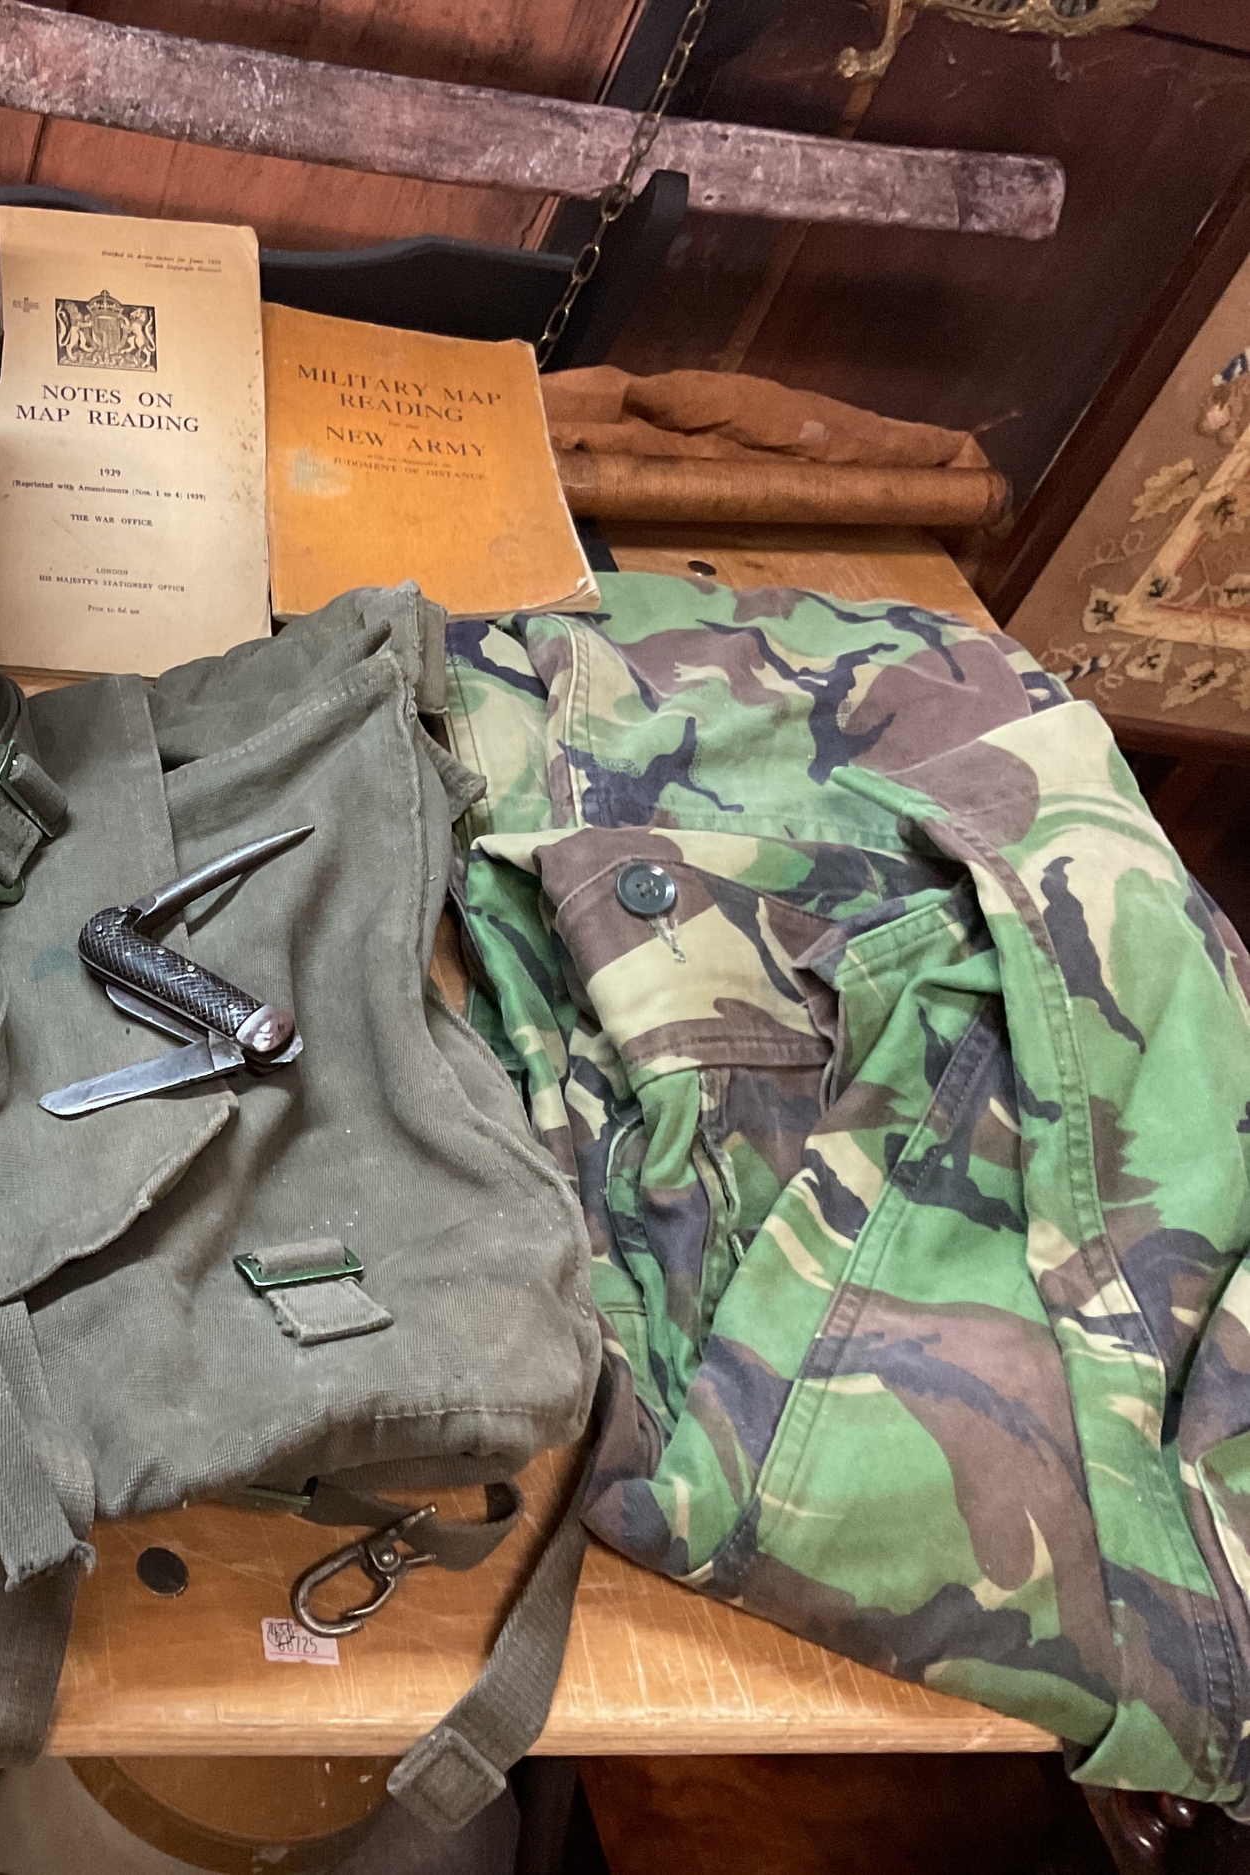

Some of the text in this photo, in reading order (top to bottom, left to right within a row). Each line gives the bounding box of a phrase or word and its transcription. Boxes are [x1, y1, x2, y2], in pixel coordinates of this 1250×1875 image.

[297, 363, 501, 406] MILITARY MAP
[42, 384, 173, 408] NOTES ON
[340, 393, 464, 423] READING
[15, 404, 199, 433] MAP READING
[326, 425, 486, 458] NEW ARMY
[99, 468, 121, 477] 1929
[333, 456, 397, 473] JUDGMENT
[57, 482, 74, 491] with
[78, 484, 129, 494] Amendments
[70, 513, 153, 527] THE WAR OFFICE
[96, 567, 129, 576] LONDON
[39, 574, 185, 592] HIS MAJESTY'S STATIONERY OFFICE
